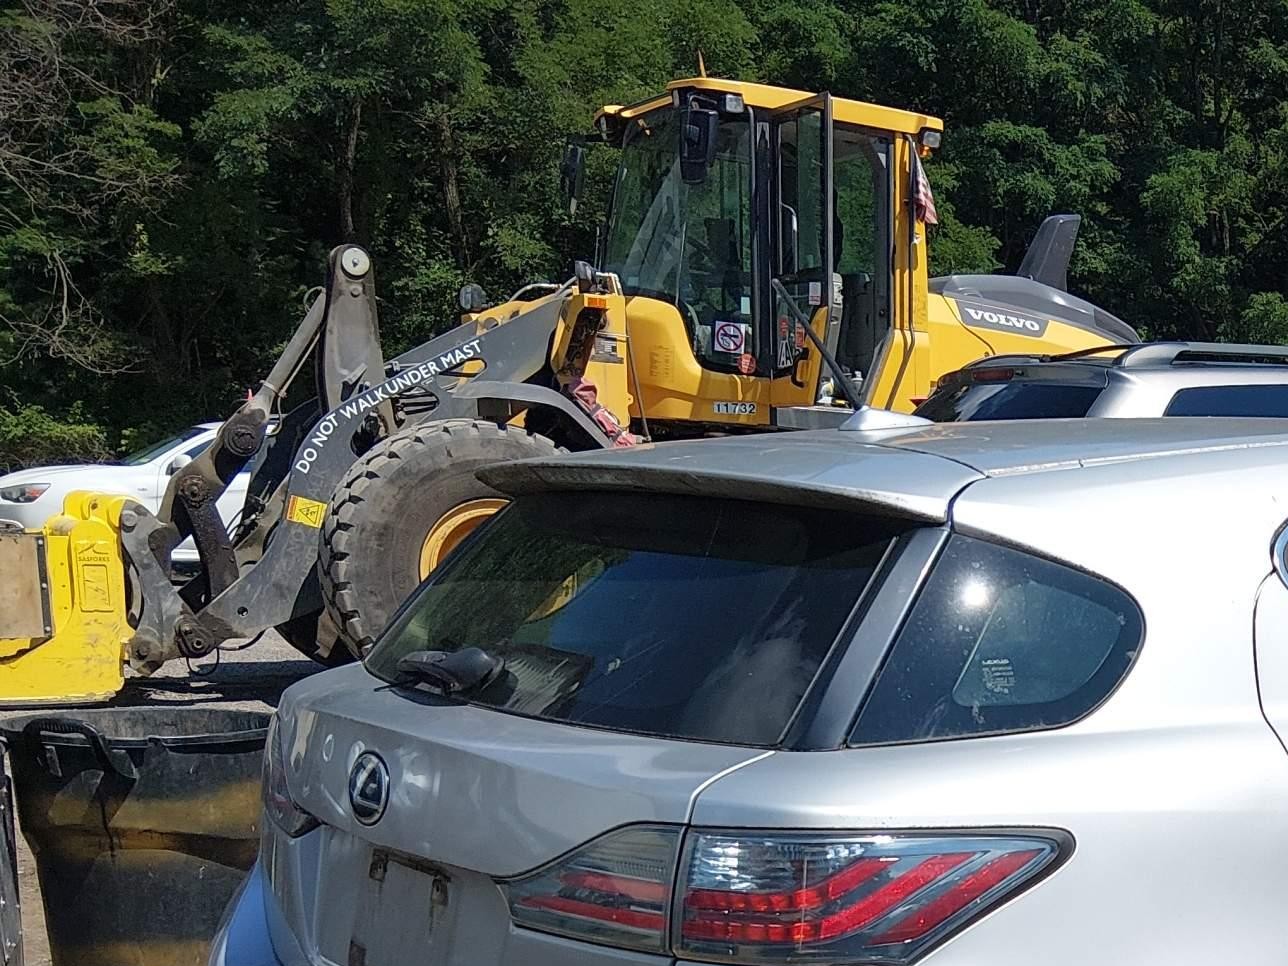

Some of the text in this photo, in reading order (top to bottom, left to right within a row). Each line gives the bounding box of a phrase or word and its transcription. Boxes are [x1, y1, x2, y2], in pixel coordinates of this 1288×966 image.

[964, 307, 1040, 331] VOLVO
[295, 339, 482, 475] DO NOT WALK UNDER MAST
[715, 403, 756, 414] 11732
